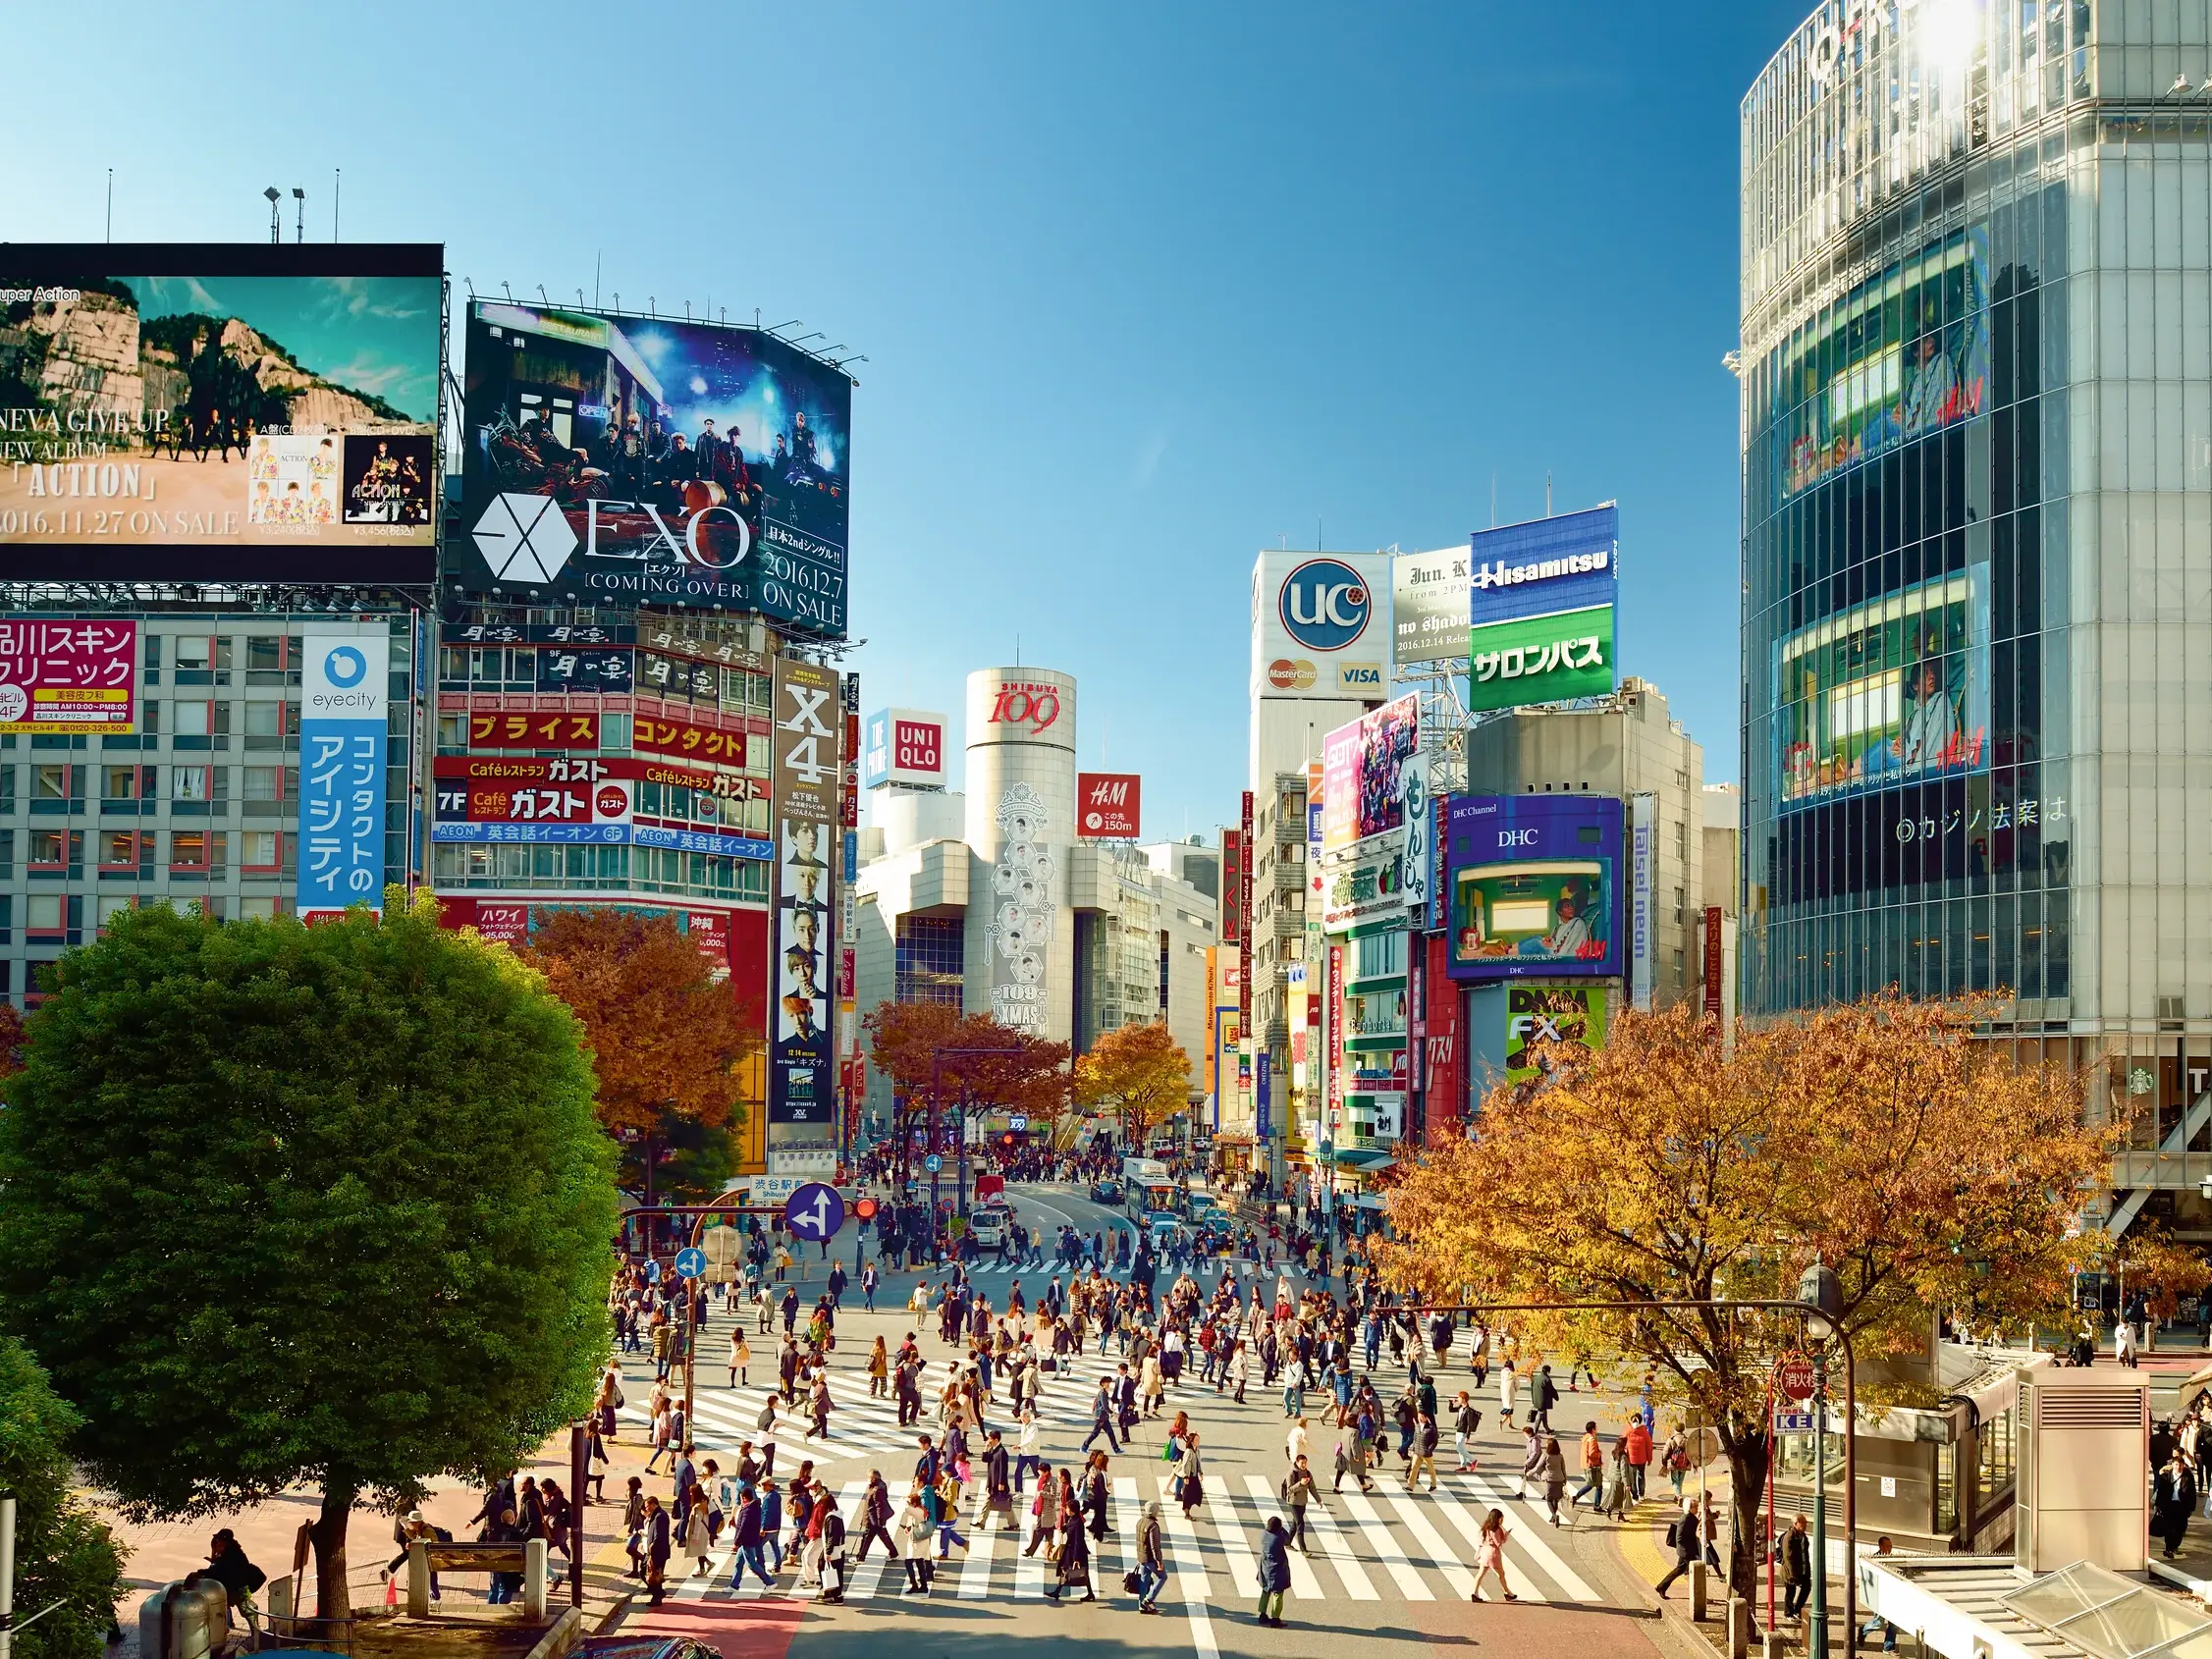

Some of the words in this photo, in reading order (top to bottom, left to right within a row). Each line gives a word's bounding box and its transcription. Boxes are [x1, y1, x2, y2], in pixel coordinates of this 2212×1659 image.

[0, 288, 30, 303] uper
[33, 286, 81, 301] Action
[0, 408, 61, 432] NEVA
[68, 408, 130, 432] GIVE
[137, 408, 169, 432] UP
[580, 405, 607, 416] OPEN
[0, 442, 34, 459] EW
[39, 443, 107, 459] ALBUM
[351, 483, 402, 499] ACTION
[0, 510, 125, 535] 016.11.27
[131, 510, 169, 535] ON
[175, 510, 239, 535] SALE
[585, 498, 750, 568] EXO
[764, 551, 843, 600] 2016.12.7
[1410, 566, 1445, 585] Jun.
[1453, 560, 1467, 577] K
[1470, 551, 1608, 589] Hisamitsu
[1410, 589, 1437, 600] from
[1443, 583, 1468, 595] 2PM
[763, 581, 792, 610] ON
[797, 592, 842, 627] SALE
[0, 624, 131, 655] 品川スキン
[460, 626, 516, 642] 月の宴
[547, 626, 605, 642] 月の宴
[1397, 621, 1417, 635] no
[651, 632, 701, 656] 月の宴
[713, 646, 760, 669] 月の宴
[1397, 636, 1443, 651] 2016.12.14
[549, 655, 626, 679] 月の宴
[1474, 635, 1602, 682] サロンパス
[646, 661, 713, 694] 月の宴
[1269, 669, 1317, 679] MasterCard
[1343, 669, 1380, 682] VISA
[56, 691, 104, 700] 美容皮フ科
[1001, 682, 1057, 694] SHIBUYA
[0, 706, 18, 718] 4F
[312, 693, 377, 711] eyecity
[785, 683, 833, 737] X
[988, 691, 1060, 734] 109
[472, 716, 594, 740] プライス
[634, 720, 742, 758] コンタクト
[901, 727, 933, 746] UNI
[785, 736, 837, 784] 4
[900, 747, 936, 766] QLO
[548, 758, 609, 781] ガスト
[473, 791, 507, 806] Café
[712, 774, 762, 801] ガスト
[1091, 780, 1128, 807] H&M
[438, 792, 466, 810] 7F
[510, 788, 586, 819] ガスト
[600, 799, 624, 809] ガスト
[847, 796, 856, 820] ガスト
[1453, 808, 1468, 819] DHC
[1468, 804, 1497, 817] Channel
[309, 736, 345, 891] アイシティ
[349, 736, 375, 892] コンタクトの
[439, 827, 474, 836] AEON
[487, 825, 597, 840] 英会話イーオン
[605, 829, 621, 837] 6F
[1105, 821, 1132, 830] 150m
[1405, 770, 1424, 899] もんじゃ
[641, 830, 672, 842] AEON
[680, 832, 771, 856] 英会話イーオン
[1498, 829, 1538, 847] DHC
[1311, 847, 1321, 858] 夜
[1635, 822, 1648, 892] Taisei
[481, 909, 520, 921] ハワイ
[690, 916, 714, 930] 沖縄
[1635, 900, 1645, 958] neon
[1709, 911, 1719, 990] クスリのことなら
[1001, 985, 1038, 999] 109
[1509, 989, 1590, 1013] DMM
[1001, 1005, 1038, 1024] XMAS
[1509, 1015, 1561, 1040] FX
[1428, 1019, 1455, 1092] クスリ
[1010, 1121, 1025, 1131] 109
[755, 1178, 805, 1190] 渋谷駅前
[1785, 1371, 1815, 1388] 消火栓
